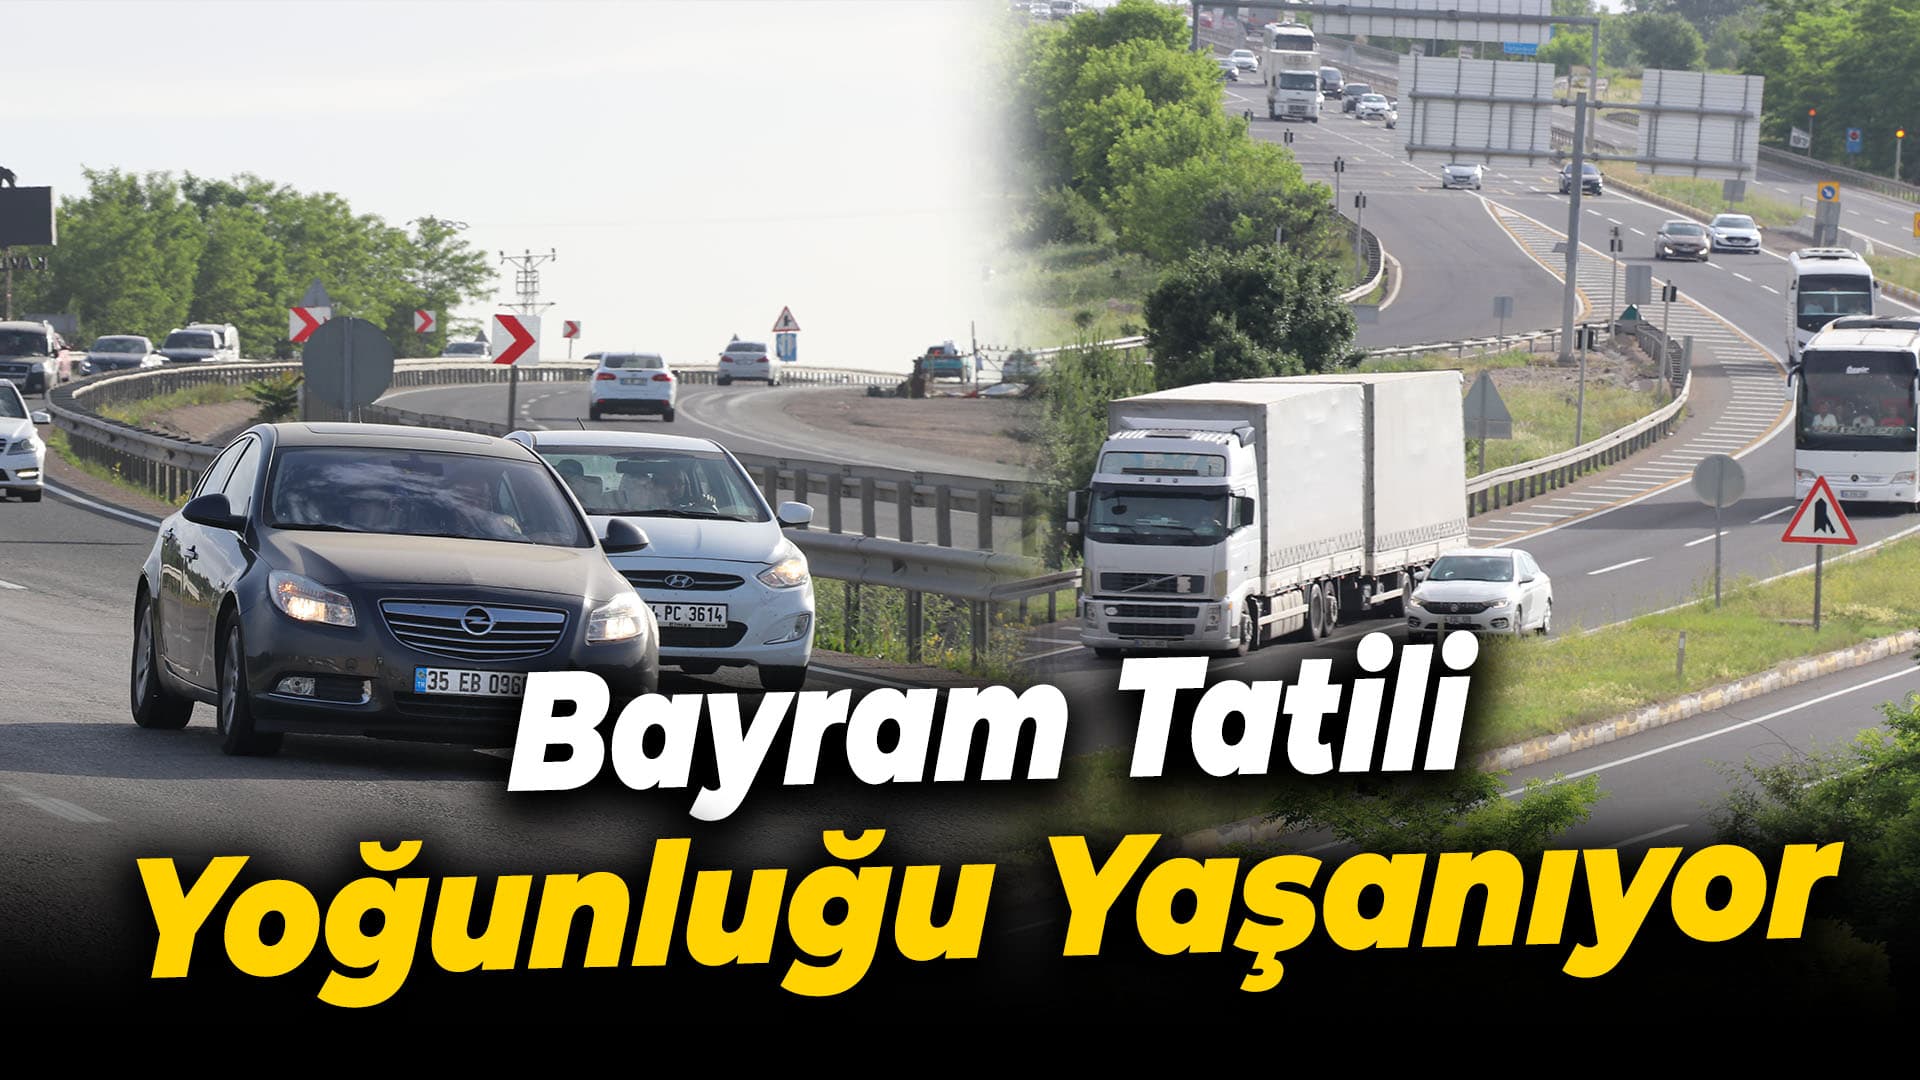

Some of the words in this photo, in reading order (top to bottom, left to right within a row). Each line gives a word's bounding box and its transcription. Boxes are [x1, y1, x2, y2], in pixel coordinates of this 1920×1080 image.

[665, 606, 681, 621] PC
[689, 607, 722, 622] 3614
[427, 671, 448, 690] 35
[460, 673, 480, 692] EB
